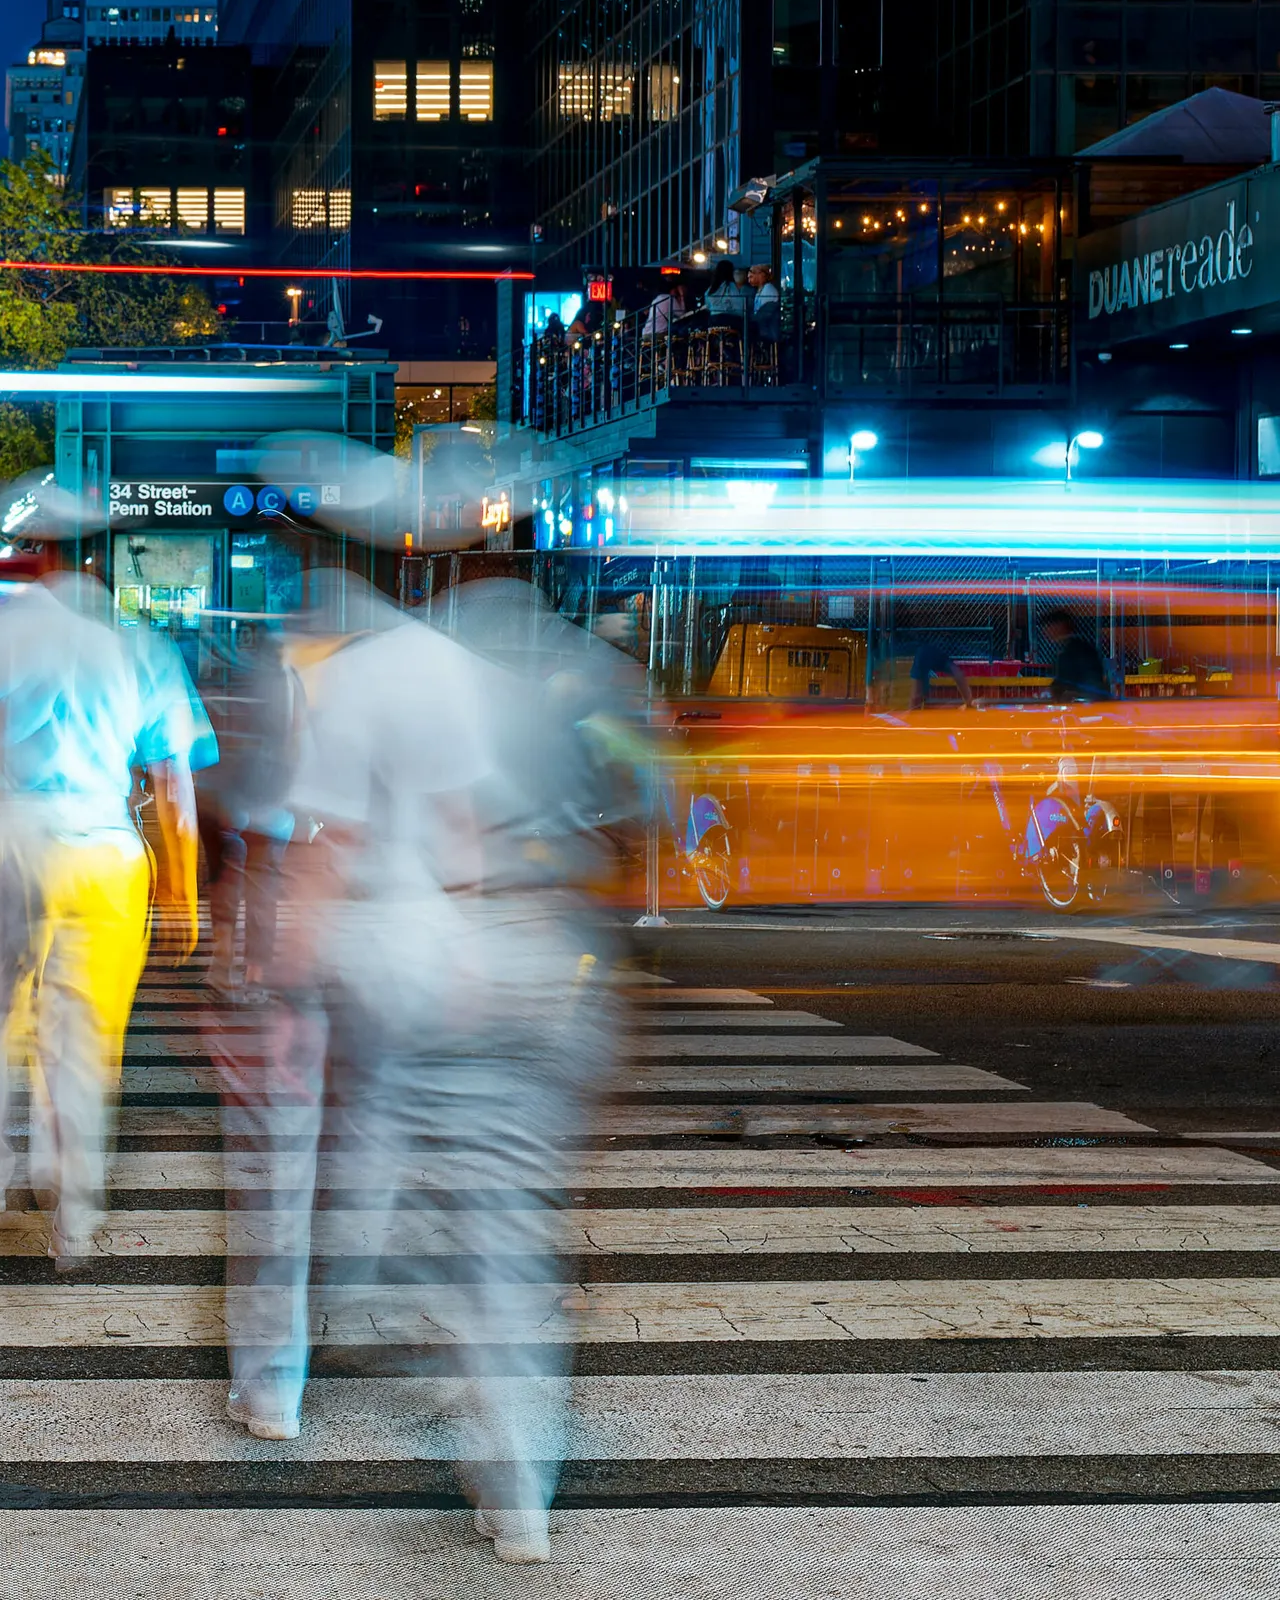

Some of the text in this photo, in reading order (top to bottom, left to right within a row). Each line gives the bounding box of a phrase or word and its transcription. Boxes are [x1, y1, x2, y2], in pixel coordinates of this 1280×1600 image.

[109, 483, 132, 500] 34
[108, 500, 213, 516] Penn Station
[231, 491, 311, 511] A C E
